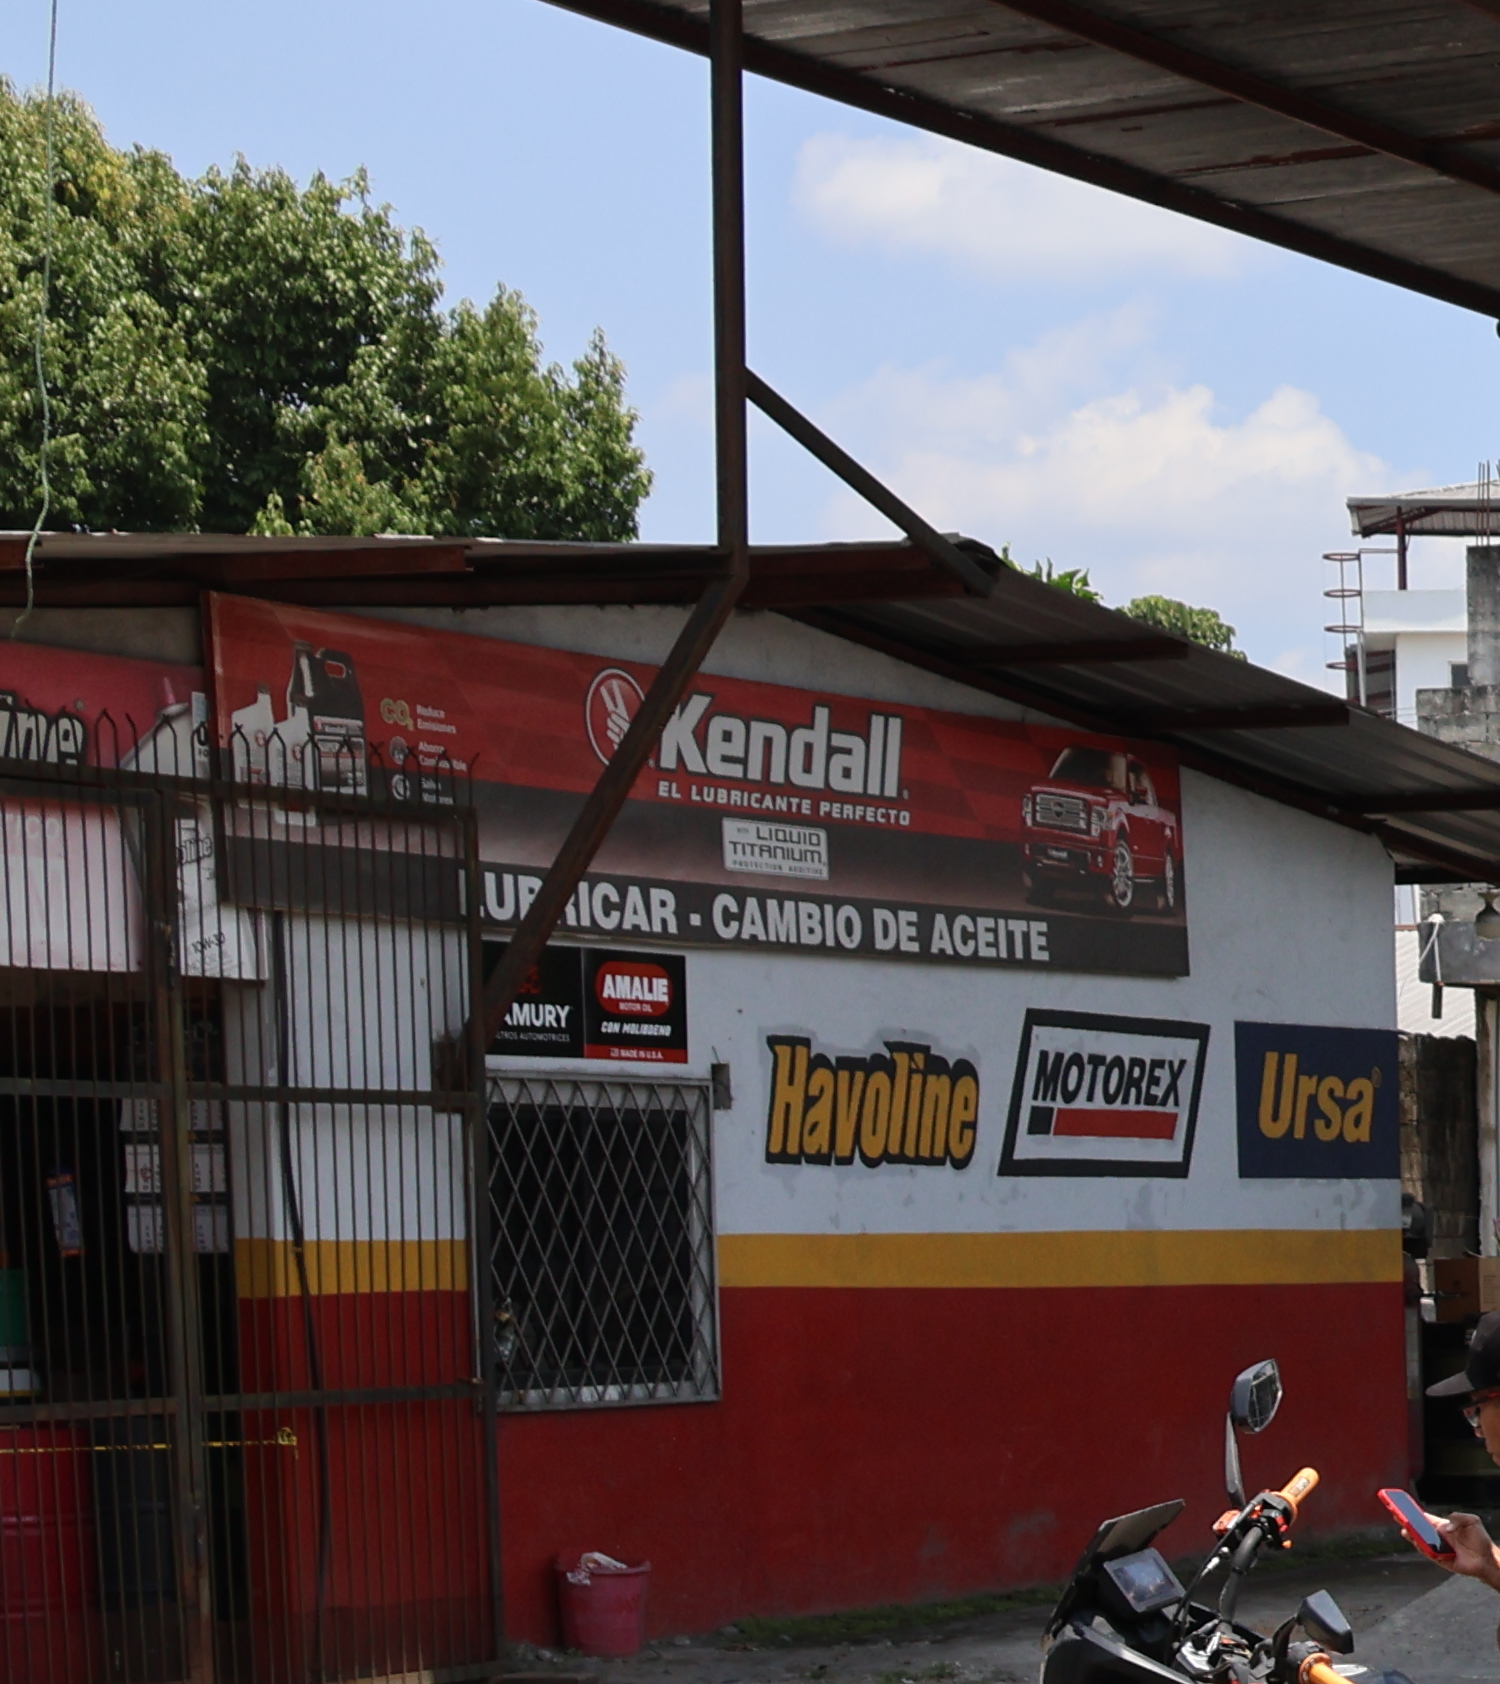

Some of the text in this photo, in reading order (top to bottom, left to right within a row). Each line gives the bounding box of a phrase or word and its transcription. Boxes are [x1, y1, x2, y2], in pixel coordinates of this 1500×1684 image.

[660, 694, 902, 798] Kendall
[658, 780, 911, 825] EL LUBRICANTE PERFECTO
[729, 841, 823, 863] TITANIUM
[756, 826, 821, 847] LIQUID
[713, 894, 862, 949] CAMBIO
[873, 911, 920, 953] DE
[930, 913, 1050, 962] ACEITE
[603, 974, 669, 1002] AMALIE
[601, 1021, 621, 1034] CON
[767, 1040, 978, 1166] Havoline
[1032, 1049, 1188, 1108] MOTOREX
[1258, 1051, 1375, 1144] Ursa
